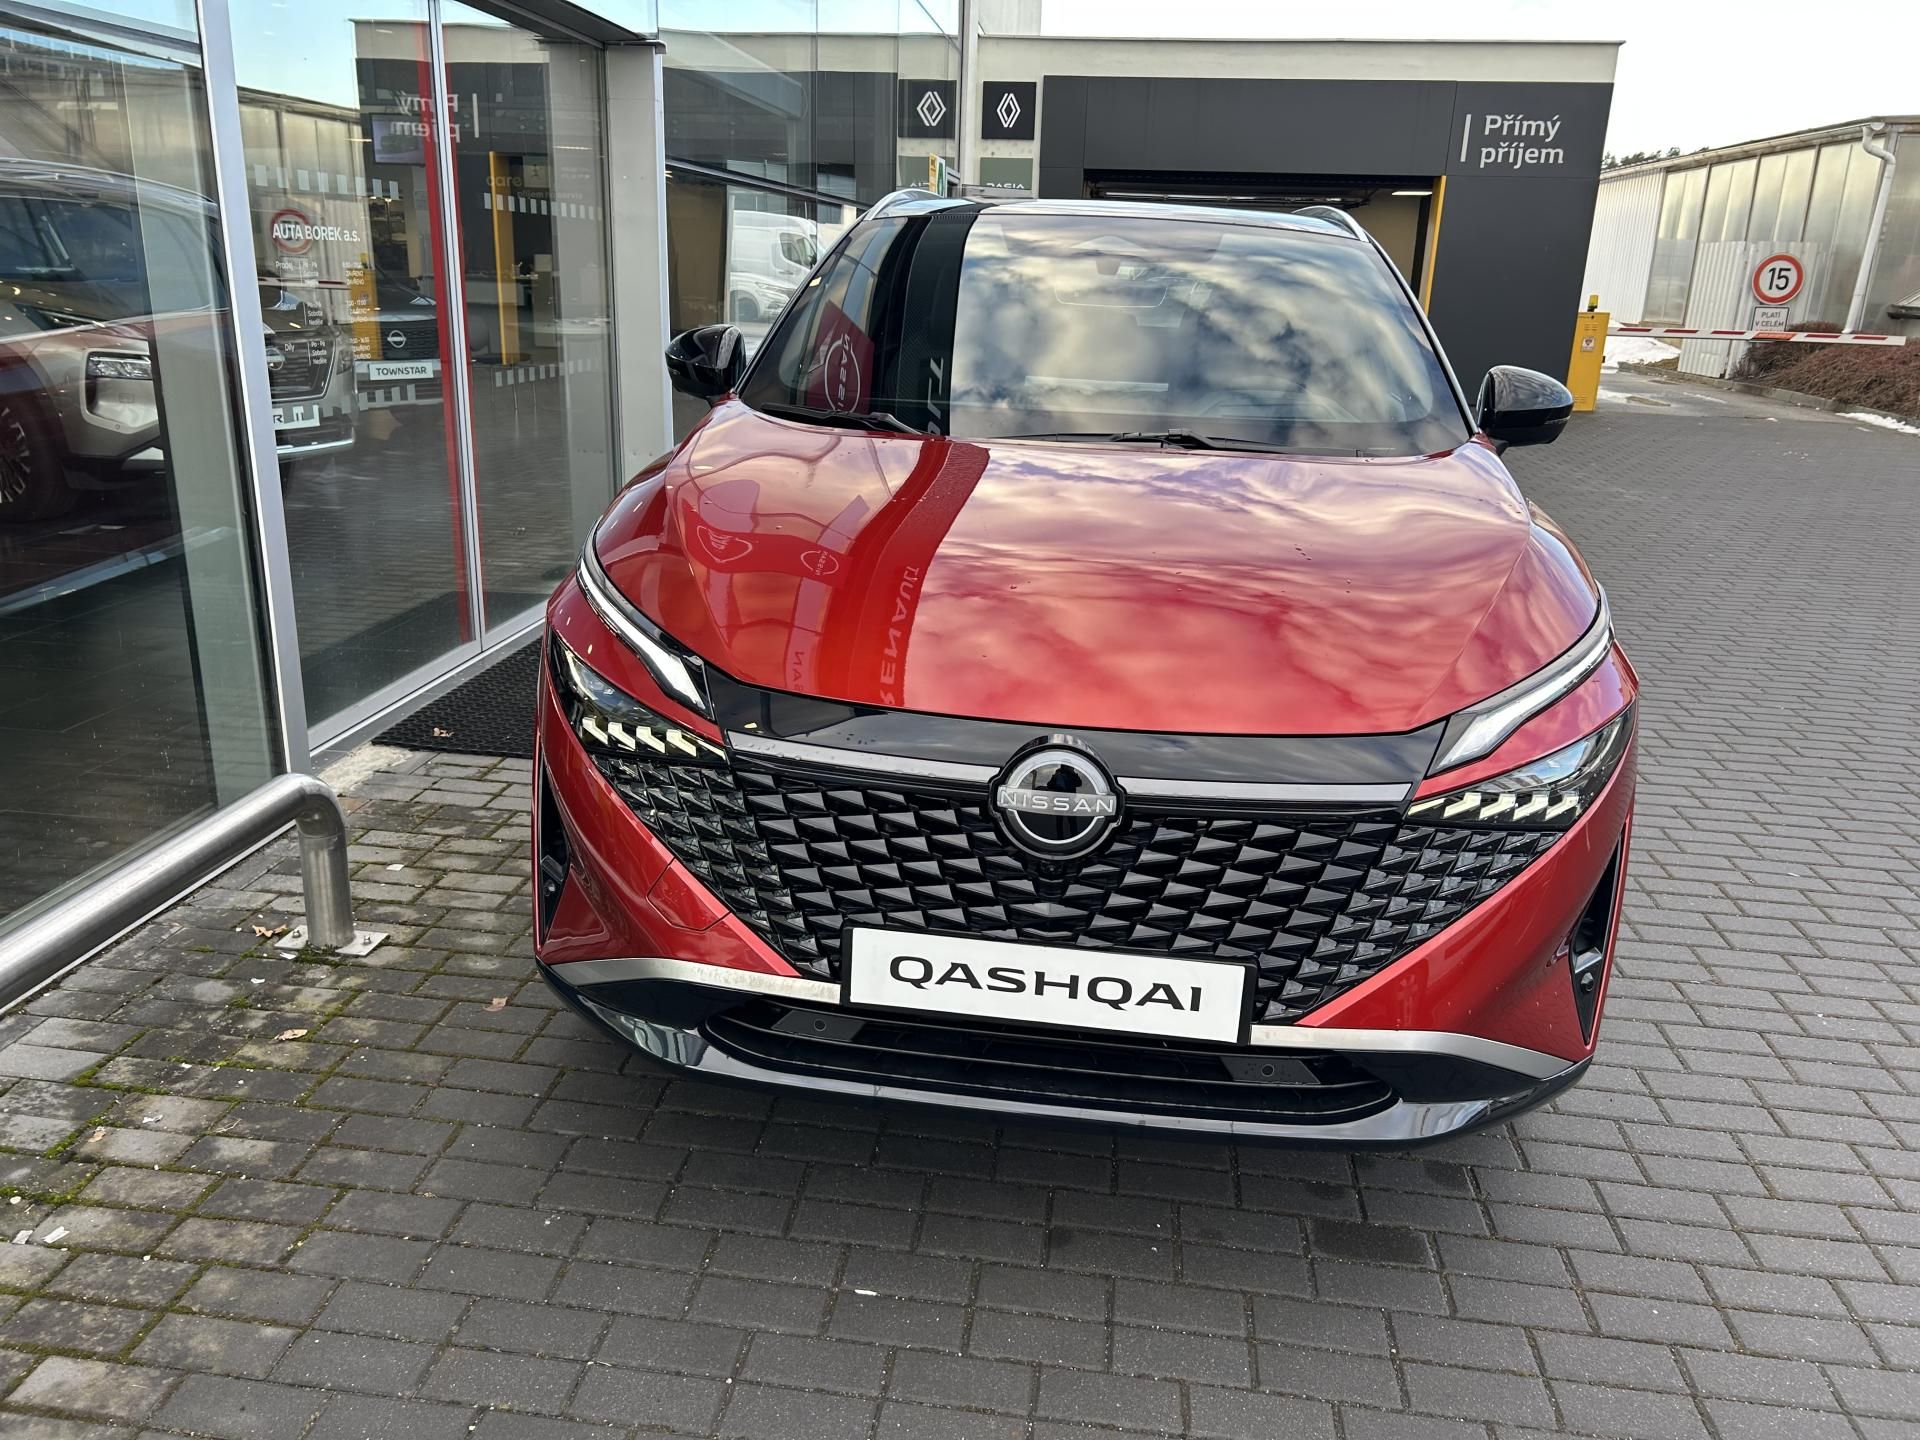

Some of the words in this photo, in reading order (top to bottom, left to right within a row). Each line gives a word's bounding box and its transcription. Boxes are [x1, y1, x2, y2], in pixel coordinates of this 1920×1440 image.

[1484, 114, 1561, 142] Přímý
[1480, 141, 1564, 169] příjem
[272, 223, 302, 240] AUTA
[305, 225, 341, 241] BOREK
[343, 230, 361, 242] a.s.
[1767, 267, 1792, 291] 15
[376, 366, 427, 376] TOWNSTAR
[1000, 790, 1114, 813] NISSAN
[889, 955, 1203, 1013] QASHQAI
